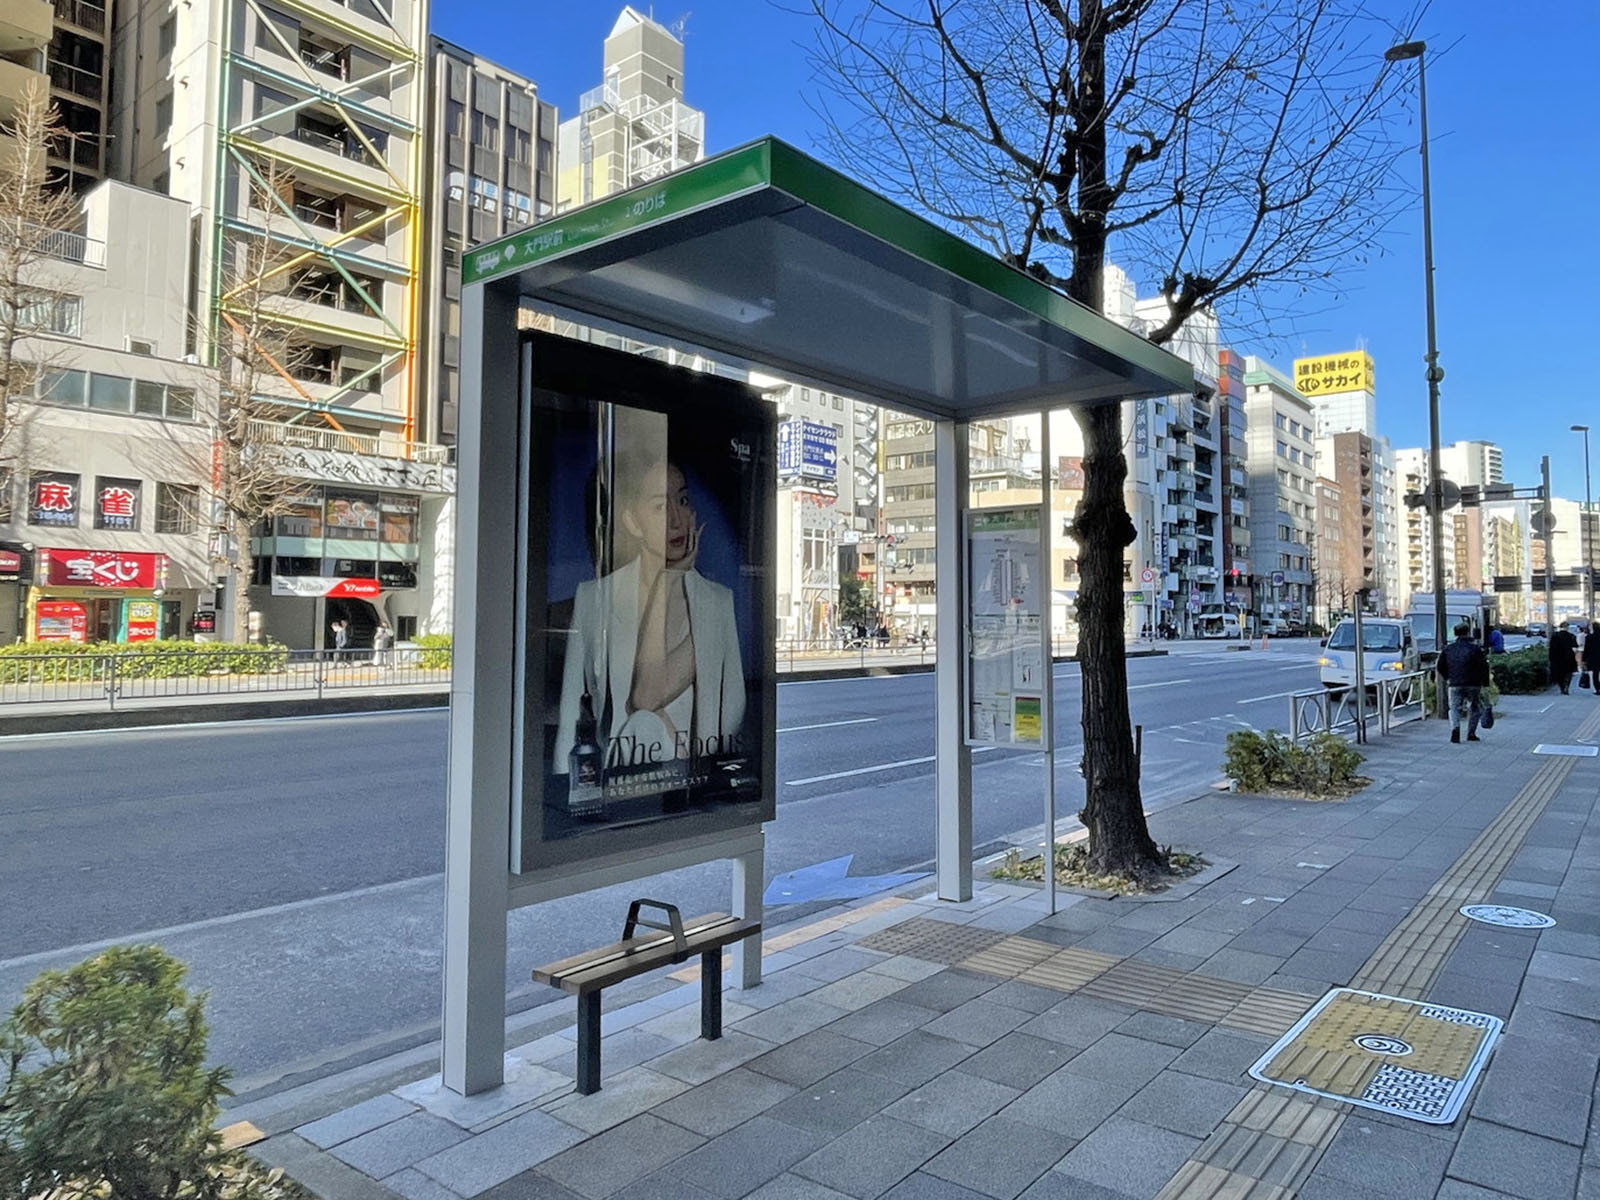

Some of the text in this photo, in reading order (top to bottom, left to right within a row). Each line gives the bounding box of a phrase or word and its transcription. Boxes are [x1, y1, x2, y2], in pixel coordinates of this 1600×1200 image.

[1298, 358, 1360, 376] 建設機械の
[1322, 372, 1362, 389] サカイ
[66, 558, 140, 581] 宝くじ
[608, 735, 662, 767] The
